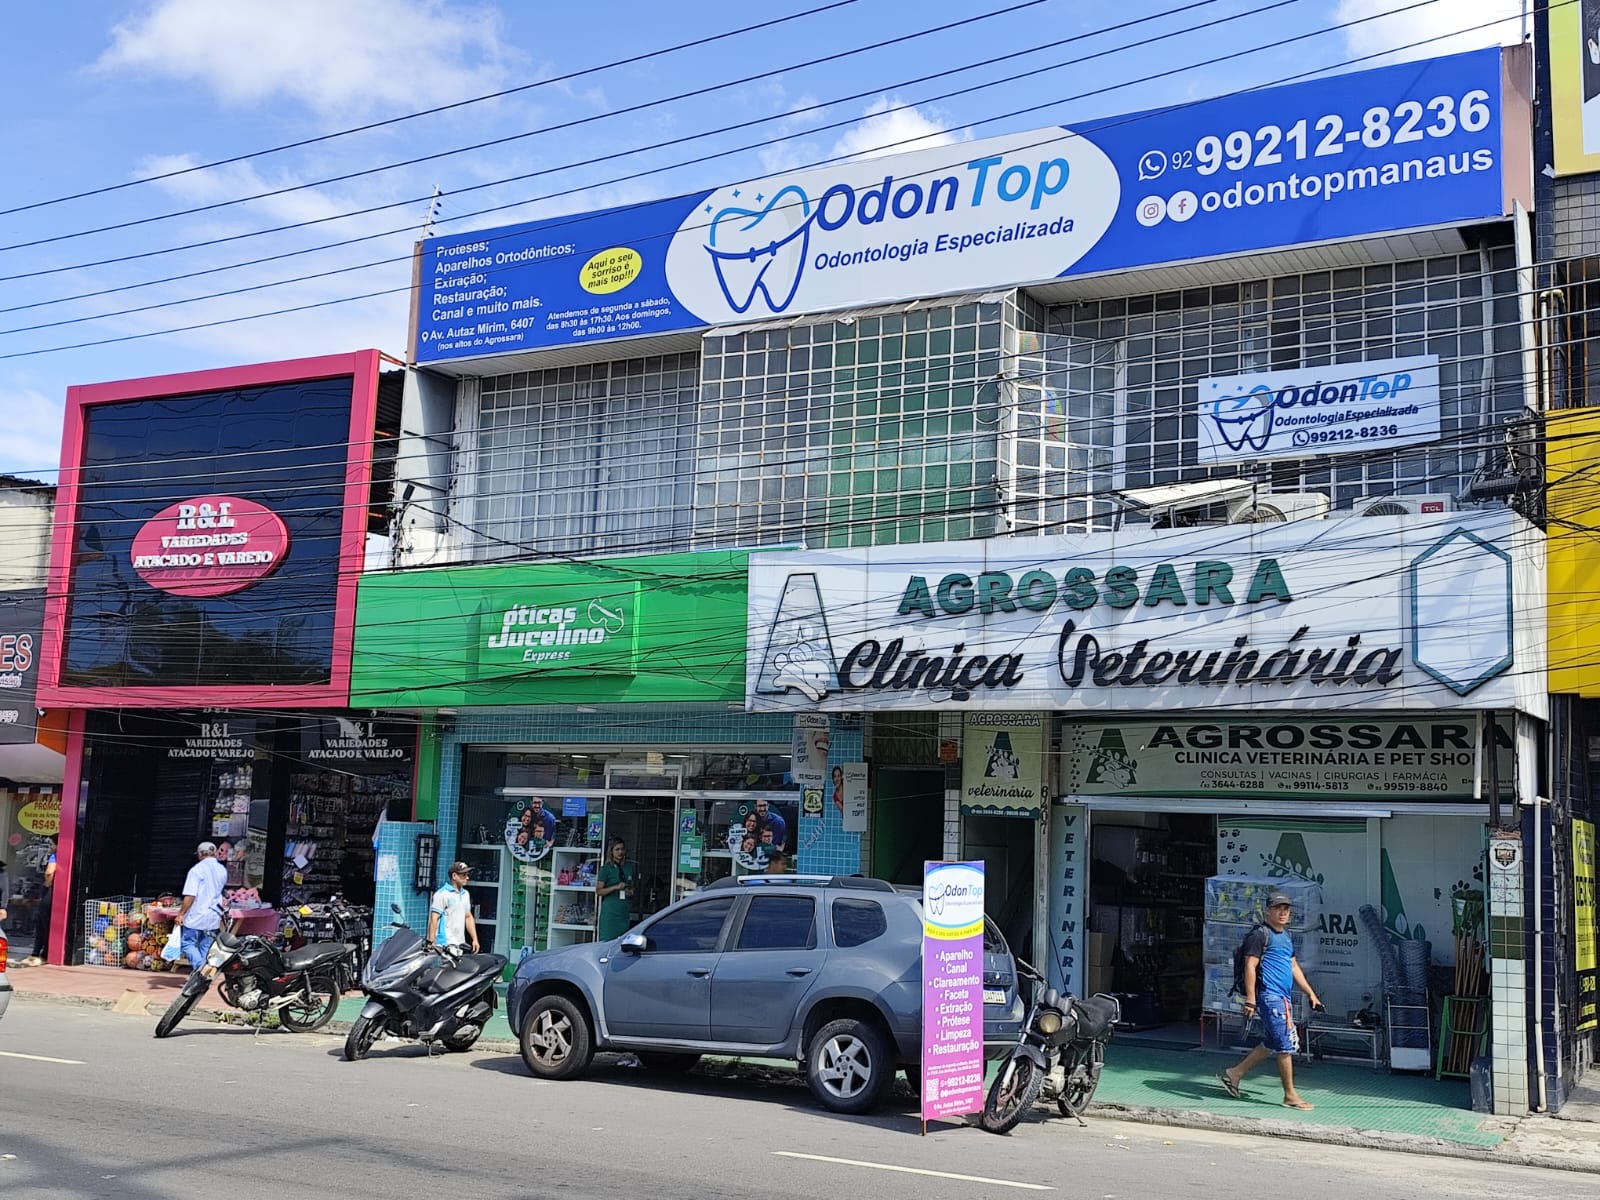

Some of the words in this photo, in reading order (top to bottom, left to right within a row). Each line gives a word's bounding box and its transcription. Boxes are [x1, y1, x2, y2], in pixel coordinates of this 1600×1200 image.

[1172, 151, 1193, 170] 92
[1195, 89, 1491, 176] 99212-8236
[1201, 149, 1494, 213] odontopmanaus
[815, 156, 1070, 231] OdonTop
[814, 242, 928, 271] Odontologia
[934, 215, 1075, 253] Especializada
[434, 256, 493, 275] Aparelhos
[495, 243, 576, 265] Ortodônticos;
[587, 257, 608, 271] Aqui
[617, 252, 634, 263] seu
[591, 265, 623, 279] sorriso
[587, 276, 609, 289] mais
[433, 285, 508, 305] Restauração;
[432, 306, 464, 321] Canal
[466, 307, 474, 316] e
[476, 299, 509, 315] muito
[512, 296, 544, 311] mais.
[547, 309, 589, 321] Atendemos
[589, 306, 600, 314] de
[600, 301, 633, 314] segunda
[429, 329, 445, 341] Av.
[446, 327, 476, 339] Autaz
[477, 321, 508, 335] Mirim,
[510, 316, 535, 330] 6407
[545, 321, 559, 331] das
[615, 311, 630, 322] Aos
[572, 327, 586, 338] das
[473, 337, 483, 346] do
[1275, 372, 1412, 409] OdonTop
[1274, 411, 1345, 428] Odontologia
[1310, 424, 1398, 443] 99212-8236
[176, 502, 235, 530] R&L
[160, 532, 249, 549] VARIEDADES
[132, 553, 202, 569] ATACADO
[203, 552, 214, 566] E
[217, 550, 274, 566] VAREJO
[896, 558, 1293, 618] AGROSSARA
[487, 622, 606, 648] Jucelino
[522, 649, 571, 664] Express
[1057, 617, 1404, 688] Veterinária
[969, 712, 1041, 727] AGROSSARA
[201, 722, 231, 738] R&L
[185, 738, 243, 749] VARIEDADES
[326, 738, 389, 749] VARIEDADES
[167, 748, 211, 759] ATACADO
[211, 748, 217, 758] E
[218, 748, 256, 759] VAREJO
[308, 748, 356, 759] ATACADO
[363, 748, 404, 759] VAREJO
[1174, 750, 1243, 765] CLINICA
[1247, 749, 1369, 766] VETERINÁRIA
[1374, 752, 1386, 766] E
[1390, 752, 1426, 766] PET
[1200, 770, 1257, 780] CONSULTAS
[1268, 771, 1312, 780] VACINAS
[1323, 771, 1380, 781] CIRURGIAS
[1392, 769, 1448, 782] FARMÁCIA
[967, 782, 1035, 799] veterinária
[1211, 780, 1265, 789] 3644-6288
[1293, 781, 1349, 790] 99114-5813
[945, 884, 983, 899] OdonTop
[1319, 937, 1334, 946] PET
[1335, 938, 1359, 948] SHOP
[939, 949, 974, 964] Aparelho
[945, 962, 968, 975] Canal
[933, 975, 980, 989] Clareamento
[944, 989, 969, 1001] Faceta
[939, 1001, 973, 1015] Extração
[941, 1015, 971, 1027] Prótese
[940, 1028, 972, 1041] Limpeza
[932, 1040, 980, 1056] Restauração
